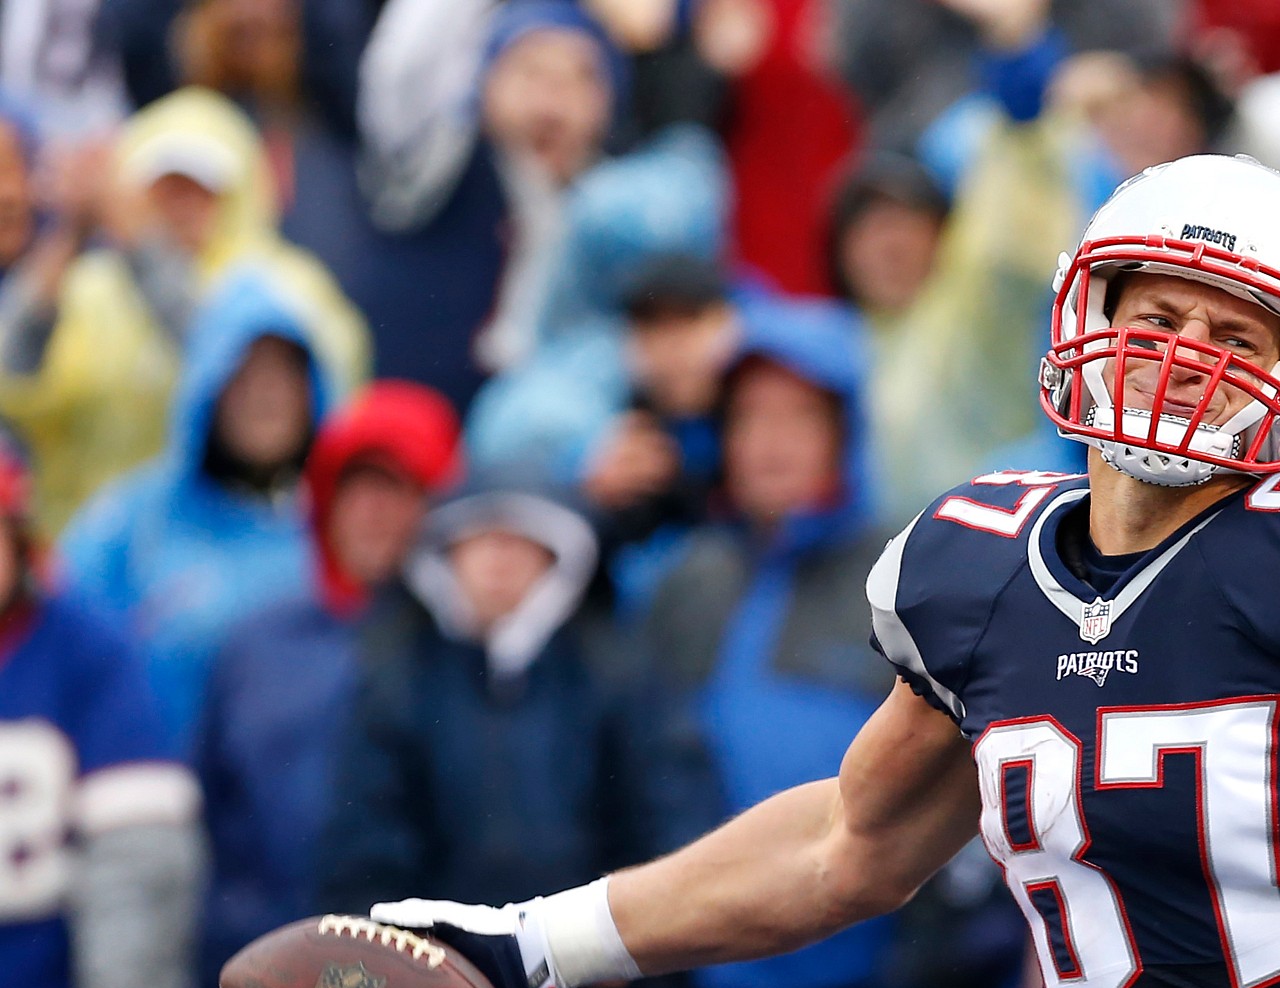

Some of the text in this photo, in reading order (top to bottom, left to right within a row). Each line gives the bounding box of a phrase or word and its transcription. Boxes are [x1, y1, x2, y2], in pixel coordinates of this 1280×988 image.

[1180, 223, 1237, 252] PATRIOTS
[1084, 616, 1106, 636] NFL
[1056, 649, 1139, 681] PATRIOTS
